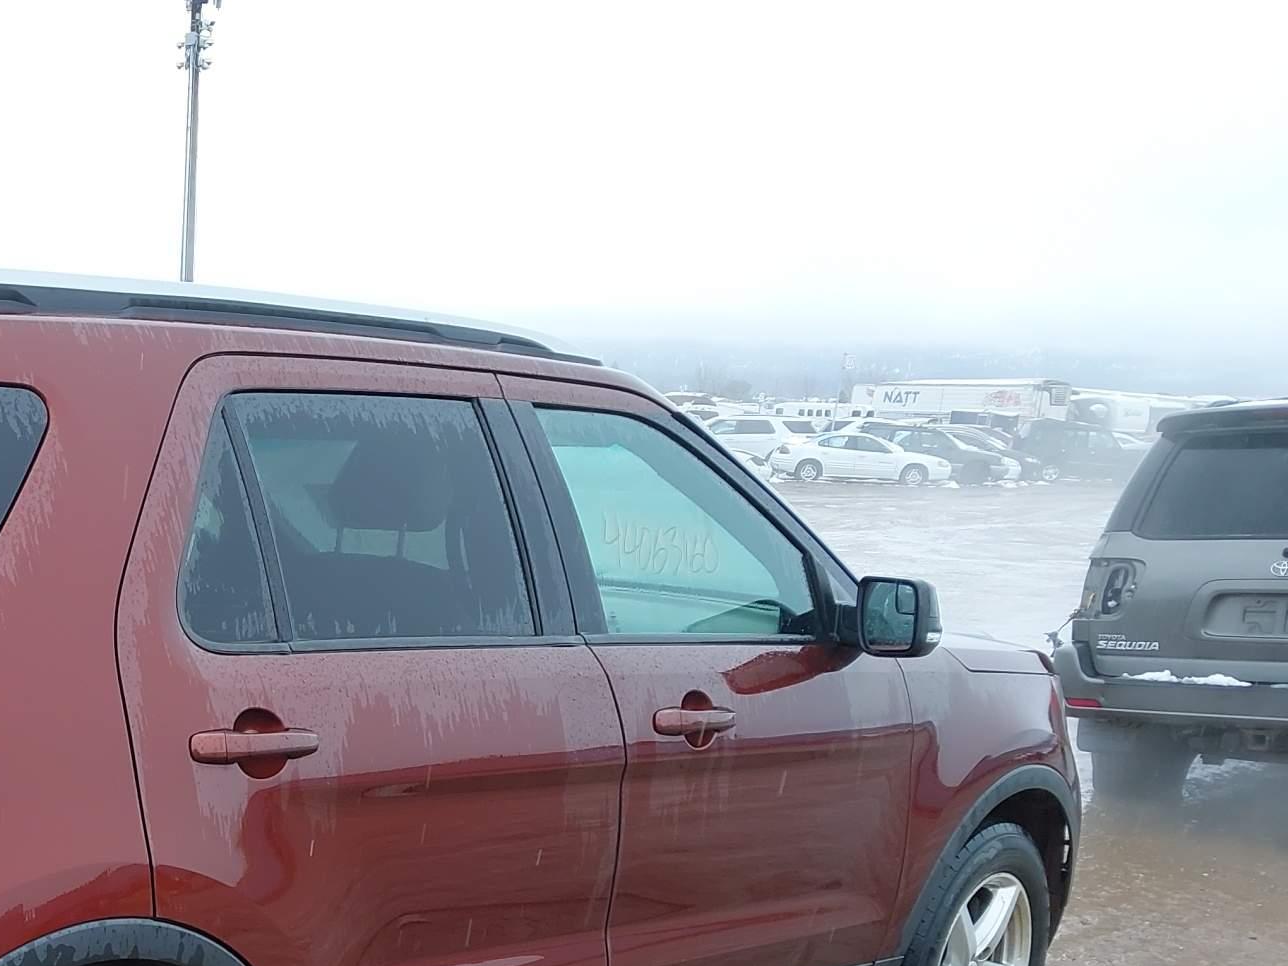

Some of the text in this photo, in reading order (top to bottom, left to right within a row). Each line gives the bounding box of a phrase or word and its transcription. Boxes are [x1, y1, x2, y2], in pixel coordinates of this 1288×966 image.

[883, 387, 920, 407] NATT
[602, 513, 721, 576] 44063160
[1096, 640, 1159, 650] SEQUOIA
